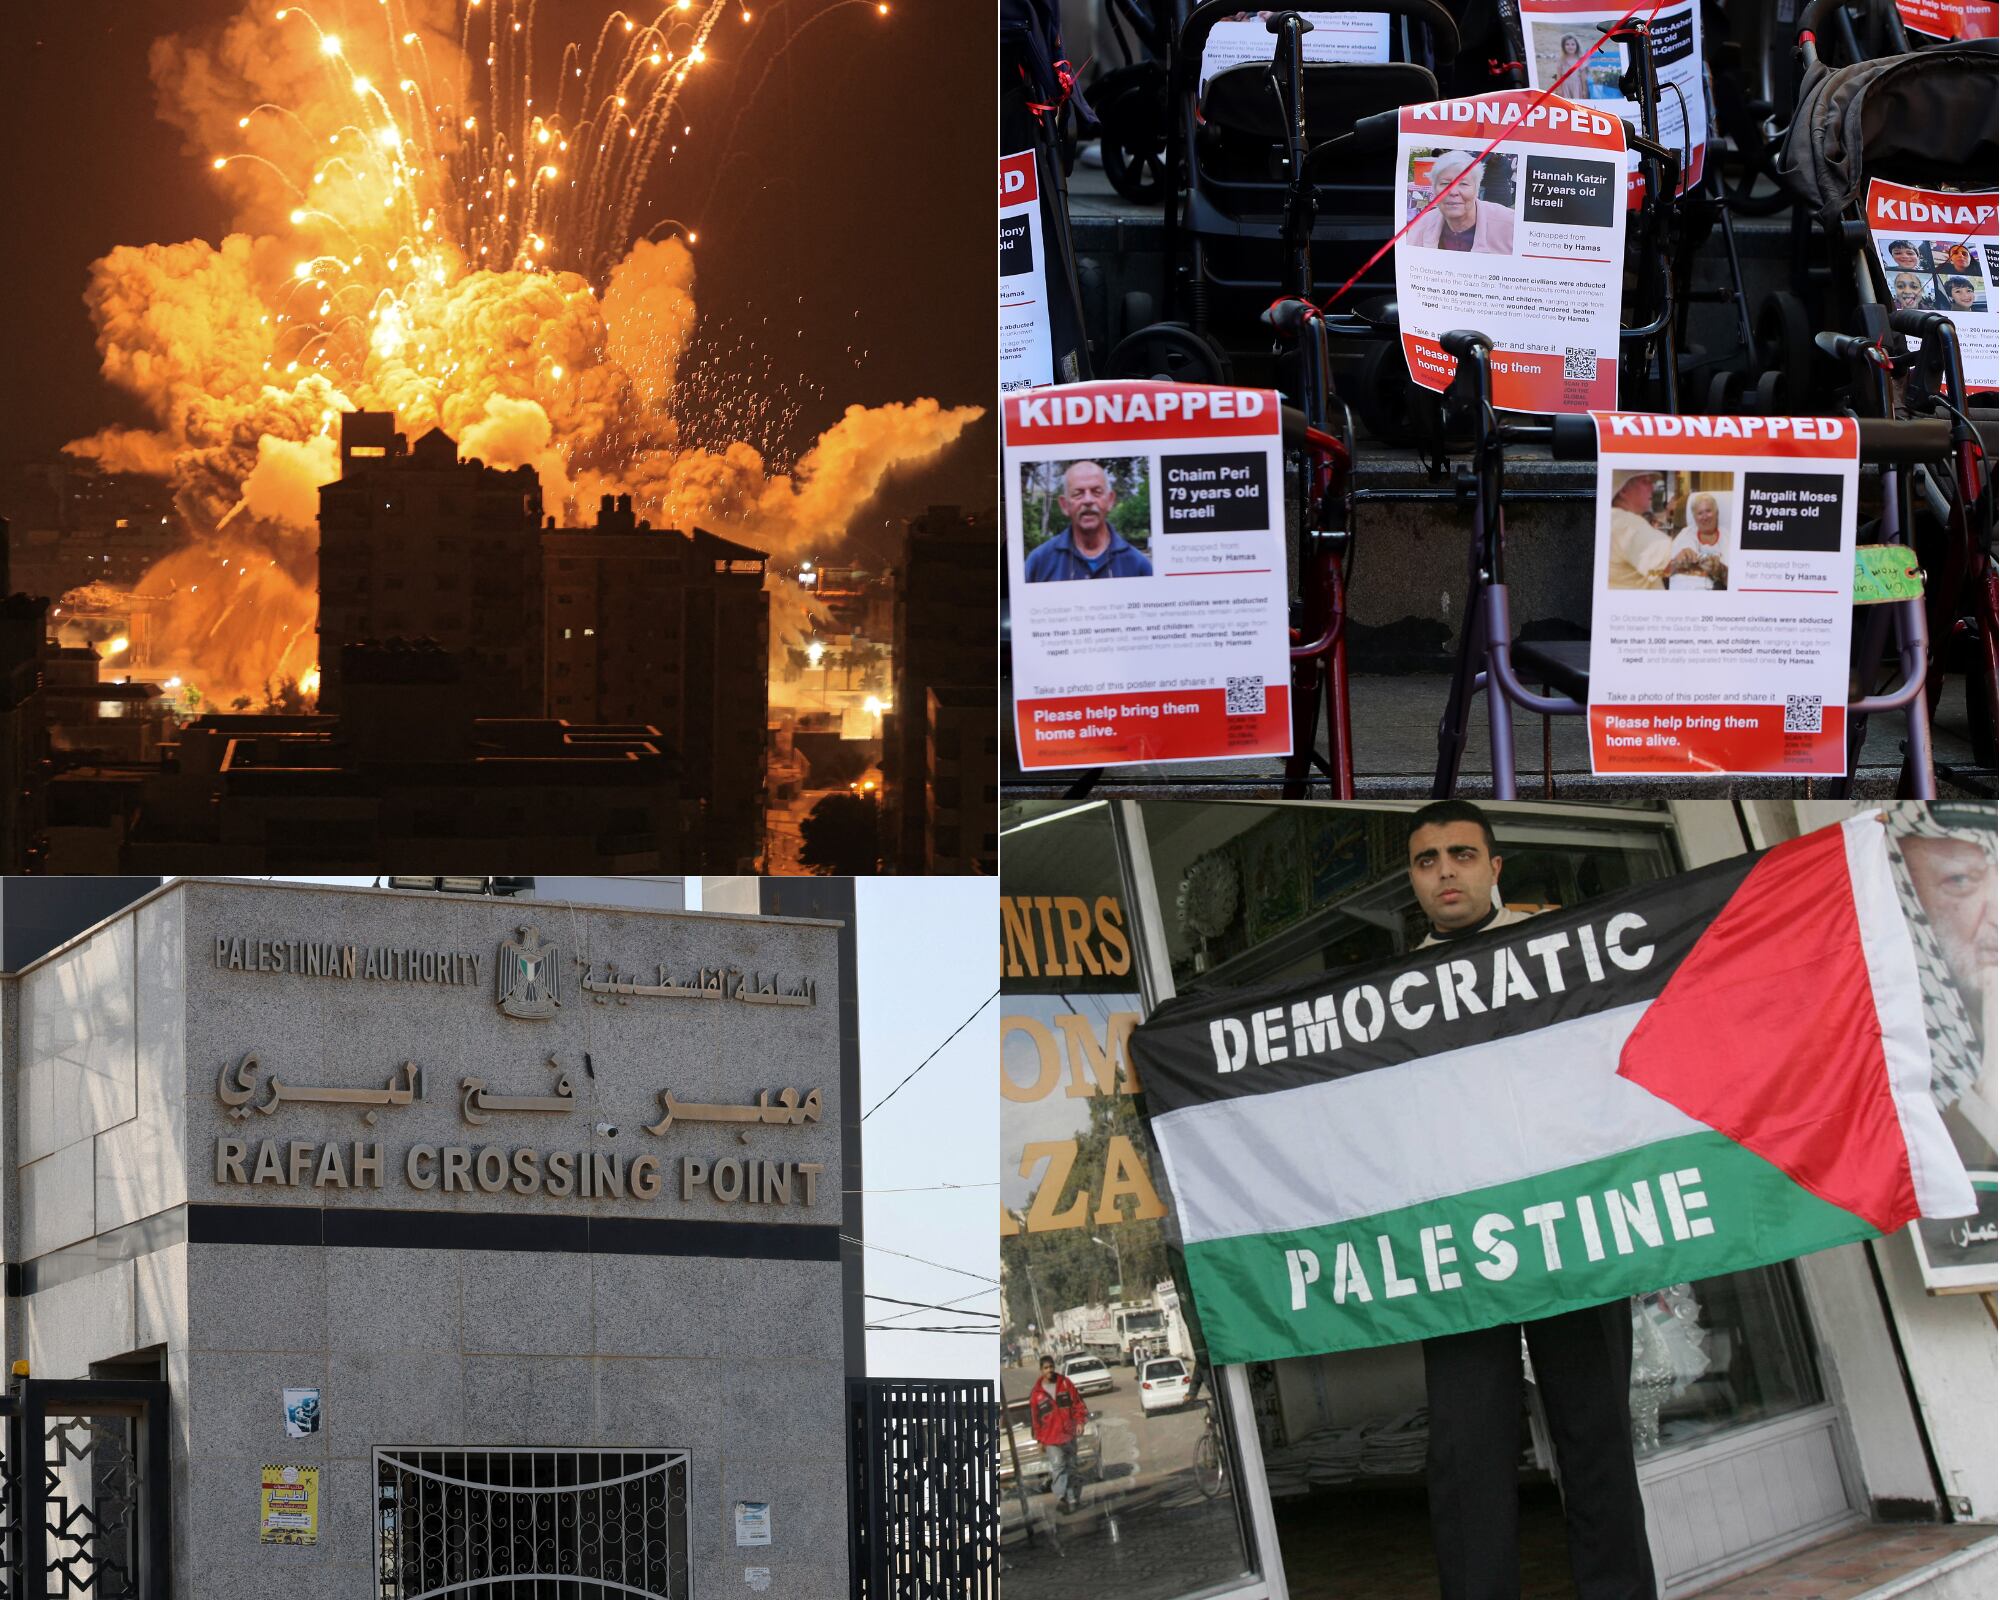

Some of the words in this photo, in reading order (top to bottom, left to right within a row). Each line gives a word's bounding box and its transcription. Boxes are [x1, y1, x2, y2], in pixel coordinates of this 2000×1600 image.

[1941, 3, 1963, 15] bring
[1966, 6, 1990, 14] them
[1664, 33, 1678, 43] old
[1652, 38, 1690, 56] li-German
[1413, 102, 1612, 136] KIDNAPPED
[1532, 170, 1572, 182] Hannah
[1576, 173, 1607, 184] Katzir
[1532, 183, 1544, 192] 77
[1547, 186, 1576, 195] years
[1580, 187, 1596, 197] old
[1531, 197, 1563, 207] Israeli
[1877, 196, 1998, 224] KIDNAP
[1529, 230, 1568, 240] Kidnapped
[1542, 241, 1561, 249] home
[1564, 243, 1573, 251] by
[1530, 278, 1557, 286] civilians
[1411, 284, 1426, 292] More
[1427, 286, 1440, 294] than
[1460, 291, 1484, 299] women,
[1004, 321, 1034, 330] abducted
[1413, 326, 1429, 336] Take
[1493, 340, 1507, 348] ster
[1510, 342, 1524, 350] and
[1415, 345, 1448, 361] Please
[1417, 358, 1445, 374] home
[1490, 360, 1508, 373] ing
[1512, 362, 1541, 374] them
[1019, 391, 1264, 427] KIDNAPPED
[1610, 416, 1843, 440] KIDNAPPED
[1168, 468, 1216, 482] Chaim
[1220, 466, 1250, 480] Peri
[1168, 487, 1187, 500] 79
[1190, 488, 1231, 503] years
[1235, 485, 1259, 498] old
[1750, 489, 1797, 503] Margalit
[1799, 491, 1837, 503] Moses
[1169, 505, 1215, 519] Israeli
[1749, 505, 1763, 516] 78
[1765, 506, 1797, 518] years
[1800, 506, 1819, 517] old
[1748, 520, 1783, 531] Israeli
[1211, 554, 1222, 563] by
[1225, 553, 1256, 561] Hamas
[1784, 573, 1795, 581] by
[1798, 573, 1827, 581] Hamas
[1178, 599, 1210, 607] civilians
[1034, 686, 1056, 695] Take
[1067, 682, 1094, 694] photo
[1097, 682, 1106, 691] of
[1108, 681, 1124, 690] this
[1127, 680, 1156, 692] poster
[1159, 678, 1177, 688] and
[1180, 677, 1205, 687] share
[1208, 677, 1215, 686] it
[1607, 692, 1627, 701] Take
[1638, 692, 1663, 702] photo
[1665, 692, 1674, 701] of
[1676, 692, 1691, 701] this
[1694, 693, 1721, 703] poster
[1723, 692, 1739, 701] and
[1742, 692, 1767, 702] share
[1769, 693, 1776, 702] it
[1033, 710, 1082, 723] Please
[1085, 707, 1117, 722] help
[1121, 705, 1159, 718] bring
[1162, 702, 1199, 715] them
[1605, 716, 1650, 729] Please
[1653, 716, 1682, 731] help
[1686, 716, 1721, 731] bring
[1724, 716, 1758, 728] them
[1035, 728, 1076, 741] home
[1079, 725, 1117, 738] alive.
[1606, 734, 1642, 746] home
[1646, 734, 1680, 746] alive.
[215, 935, 356, 979] PALESTINIAN
[364, 947, 484, 986] AUTHORITY
[1209, 911, 1656, 1075] DEMOCRATIC
[1000, 1011, 1145, 1103] OM
[641, 1087, 822, 1145] معبر
[216, 1138, 385, 1189] RAFAH
[406, 1143, 662, 1201] CROSSING
[683, 1156, 826, 1207] POINT
[1000, 1135, 1168, 1235] ZA
[1284, 1167, 1715, 1311] PALESTINE
